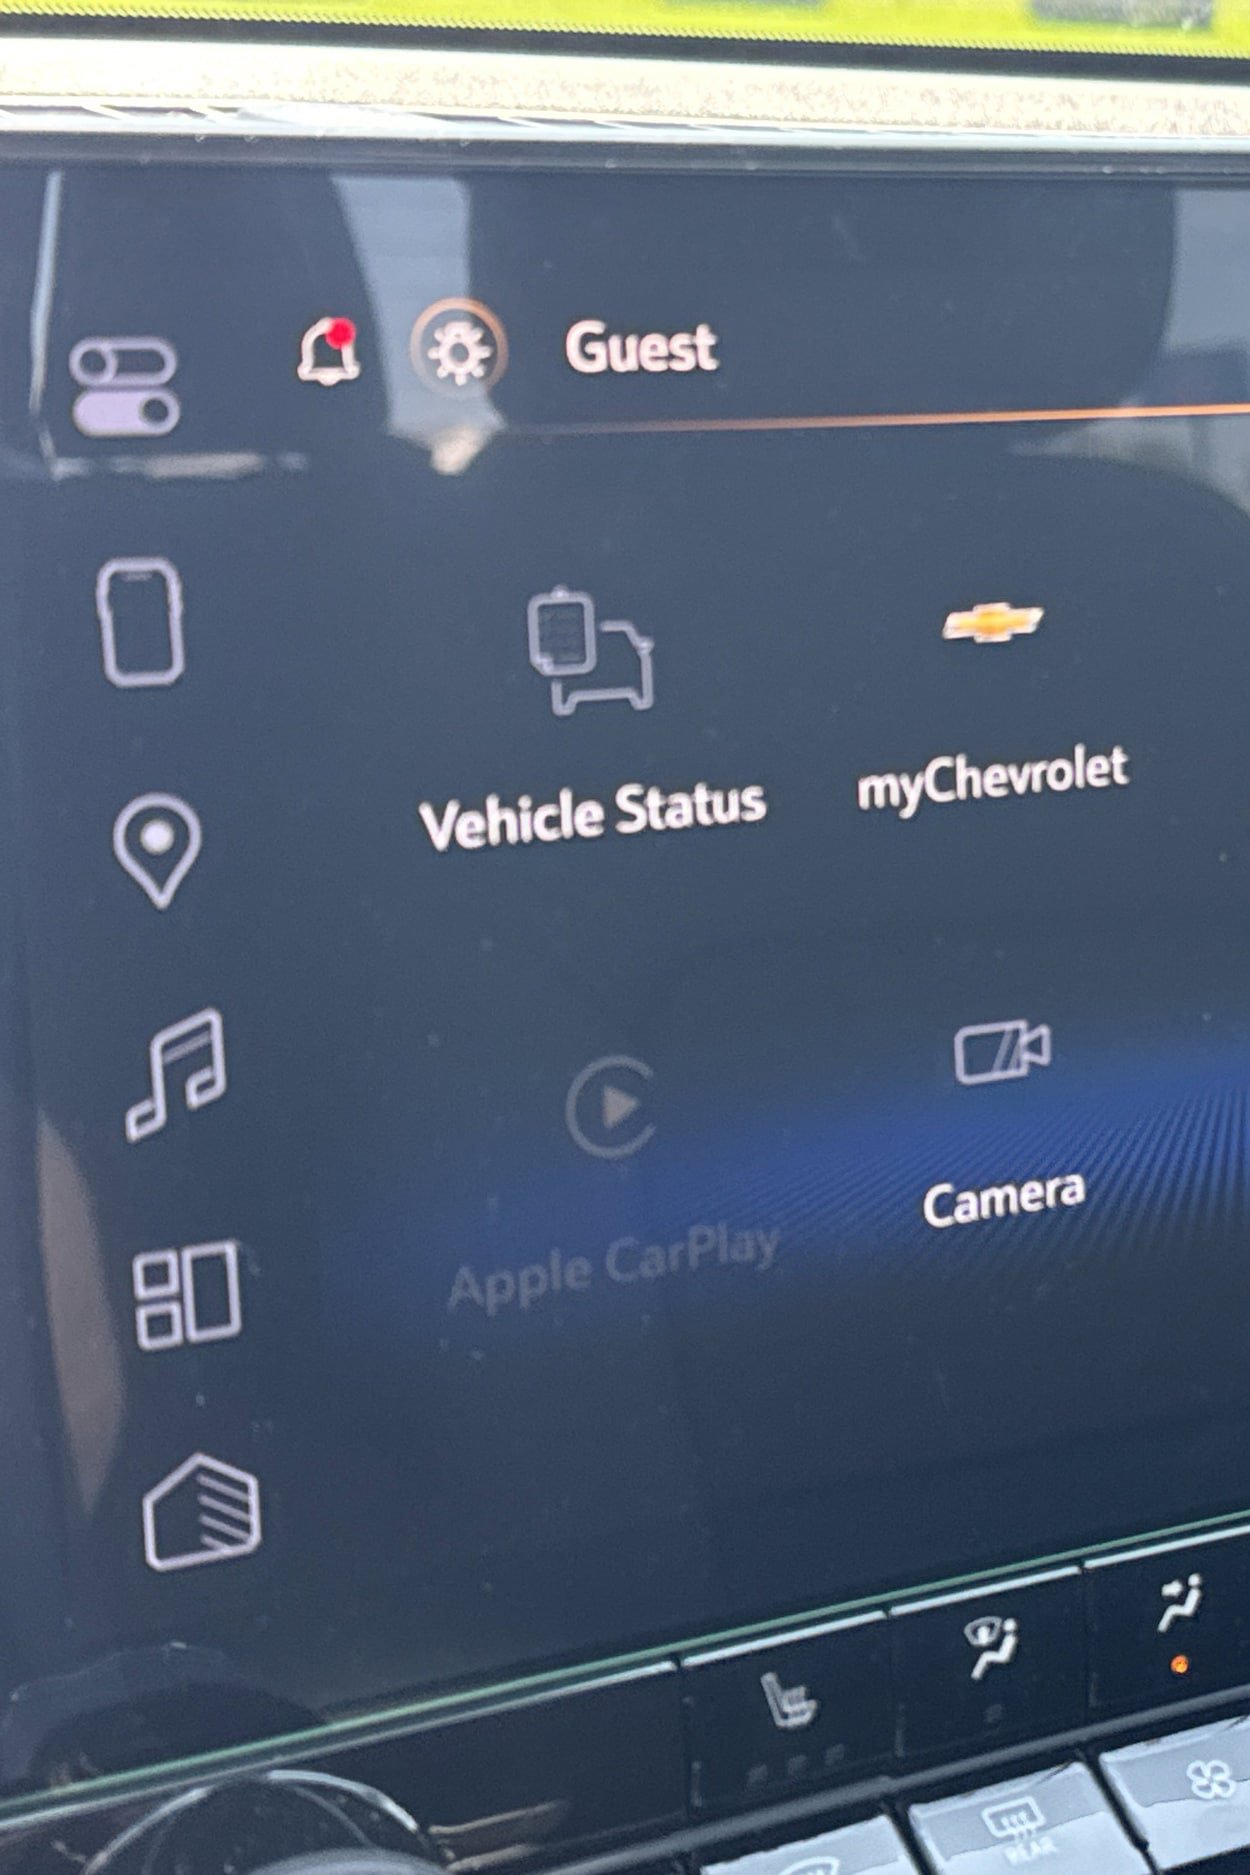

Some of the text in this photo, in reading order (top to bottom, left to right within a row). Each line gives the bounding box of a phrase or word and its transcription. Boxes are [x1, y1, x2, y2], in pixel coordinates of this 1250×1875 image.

[565, 319, 719, 373] Guest
[418, 778, 768, 853] Vehicle Status
[857, 743, 1131, 820] myChevrolet
[922, 1170, 1086, 1230] Camera
[446, 1220, 781, 1316] Apple CarPlay
